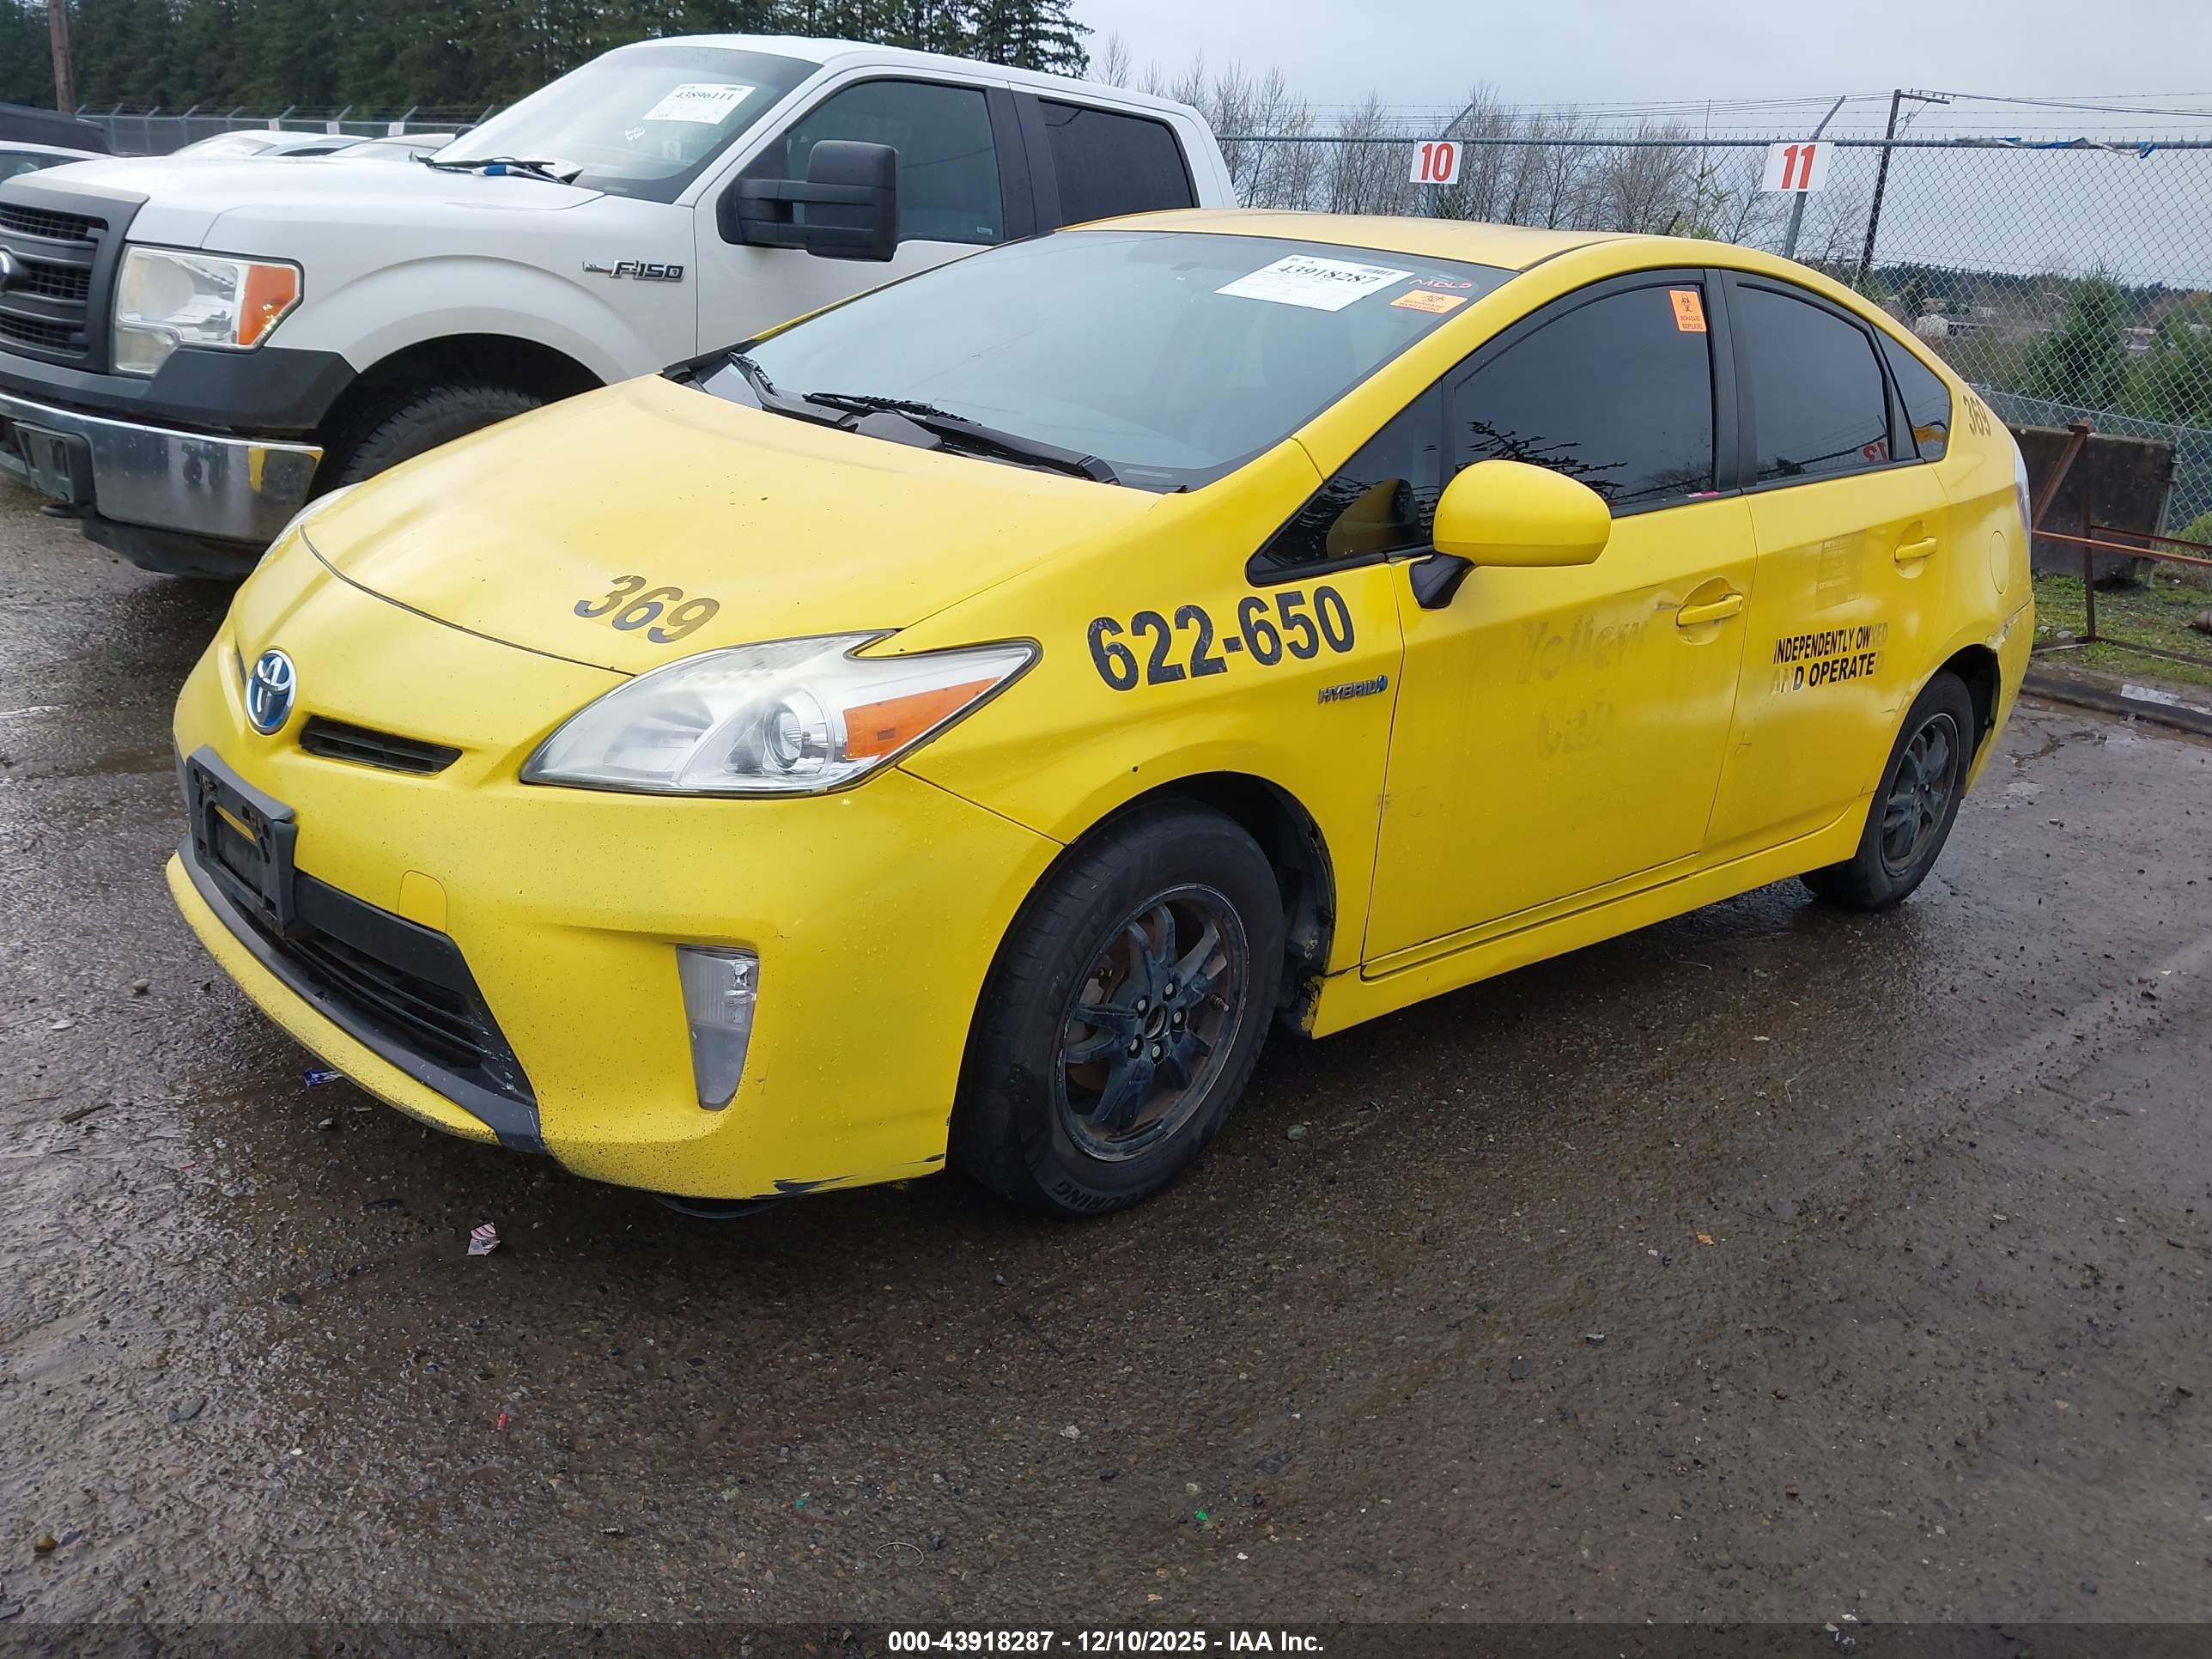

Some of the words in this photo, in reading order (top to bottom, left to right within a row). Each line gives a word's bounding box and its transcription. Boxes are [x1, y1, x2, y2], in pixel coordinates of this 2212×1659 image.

[1420, 142, 1454, 182] 10
[1780, 143, 1817, 190] 11
[609, 258, 685, 283] F-150
[1277, 264, 1382, 285] 43918287
[1962, 395, 1991, 436] 369
[574, 574, 720, 644] 369
[1086, 585, 1355, 691] 622-650
[1773, 628, 1855, 665] INDEPENDENTLY
[1318, 677, 1381, 706] HYBRID
